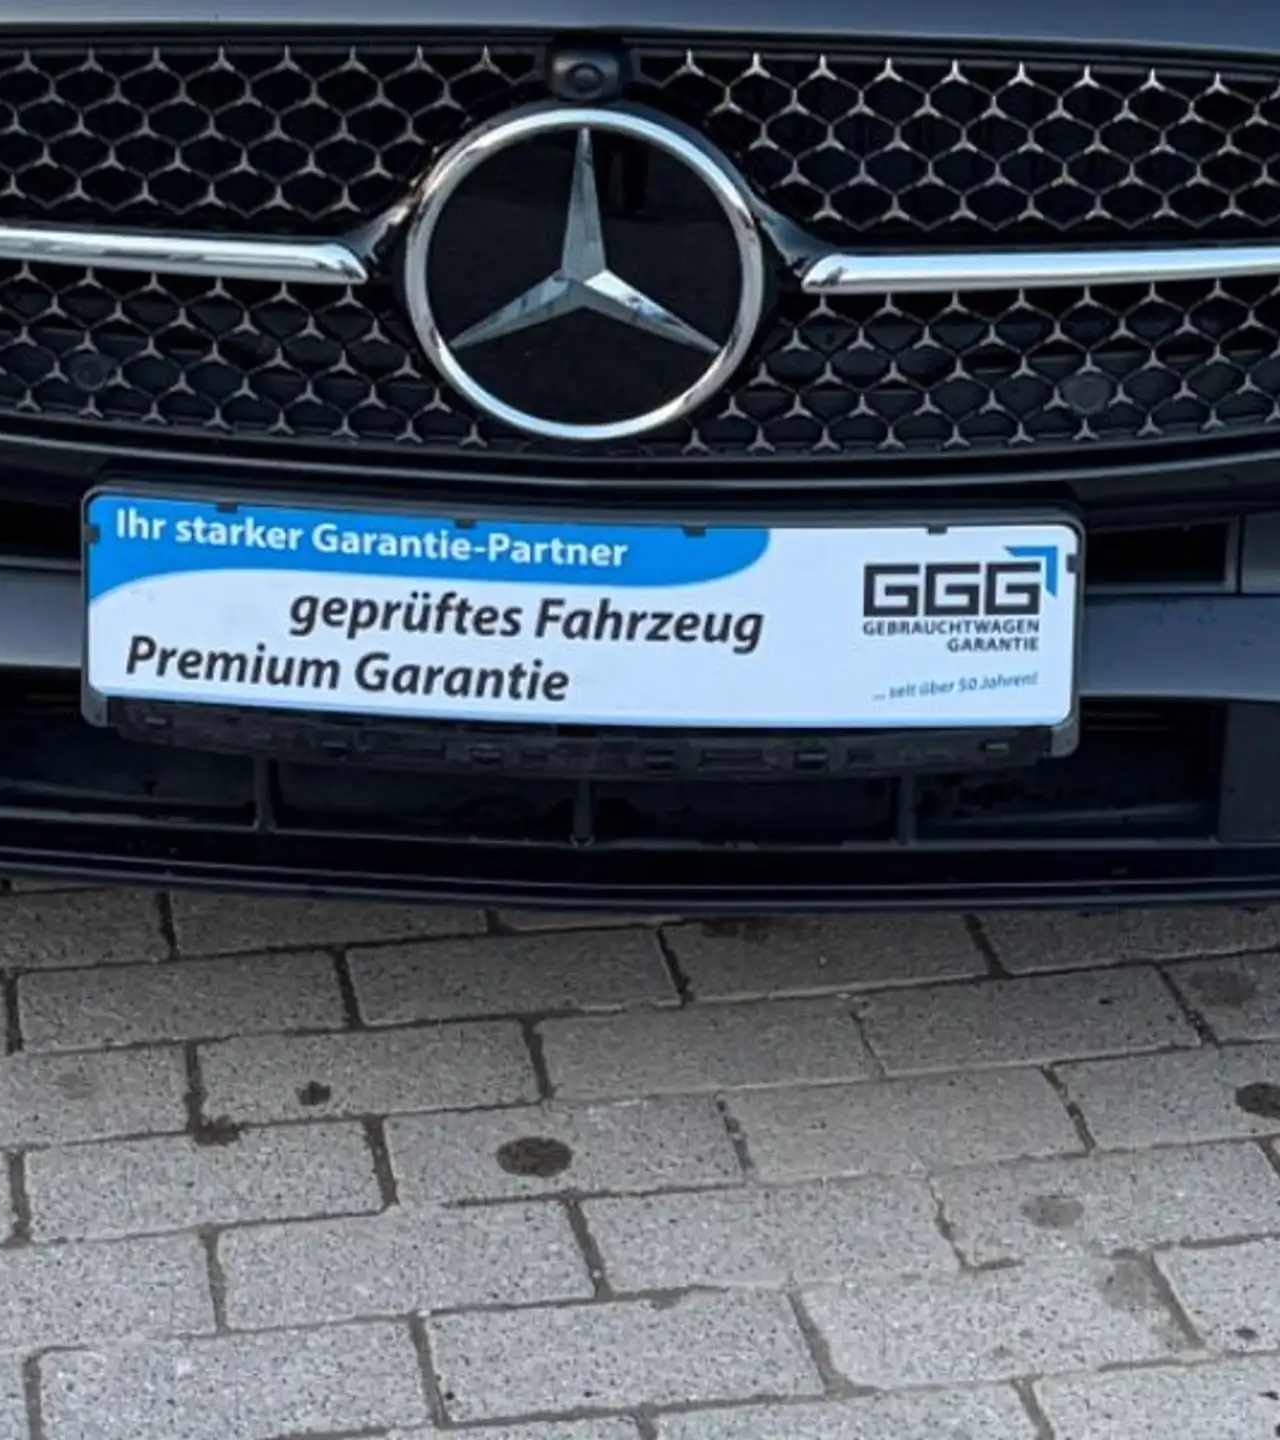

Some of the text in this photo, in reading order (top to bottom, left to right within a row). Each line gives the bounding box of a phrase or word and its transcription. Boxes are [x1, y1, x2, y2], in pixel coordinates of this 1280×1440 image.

[116, 507, 628, 567] Ihr starker Garantie-Partner
[863, 561, 1041, 617] GGG
[288, 591, 764, 655] geprüftes Fahrzeug
[862, 619, 1040, 637] GEBRAUCHTWAGEN
[947, 637, 1039, 654] GARANTIE
[126, 634, 570, 702] Premium Garantie
[889, 682, 916, 700] seit
[919, 677, 954, 697] über
[958, 676, 978, 693] 50
